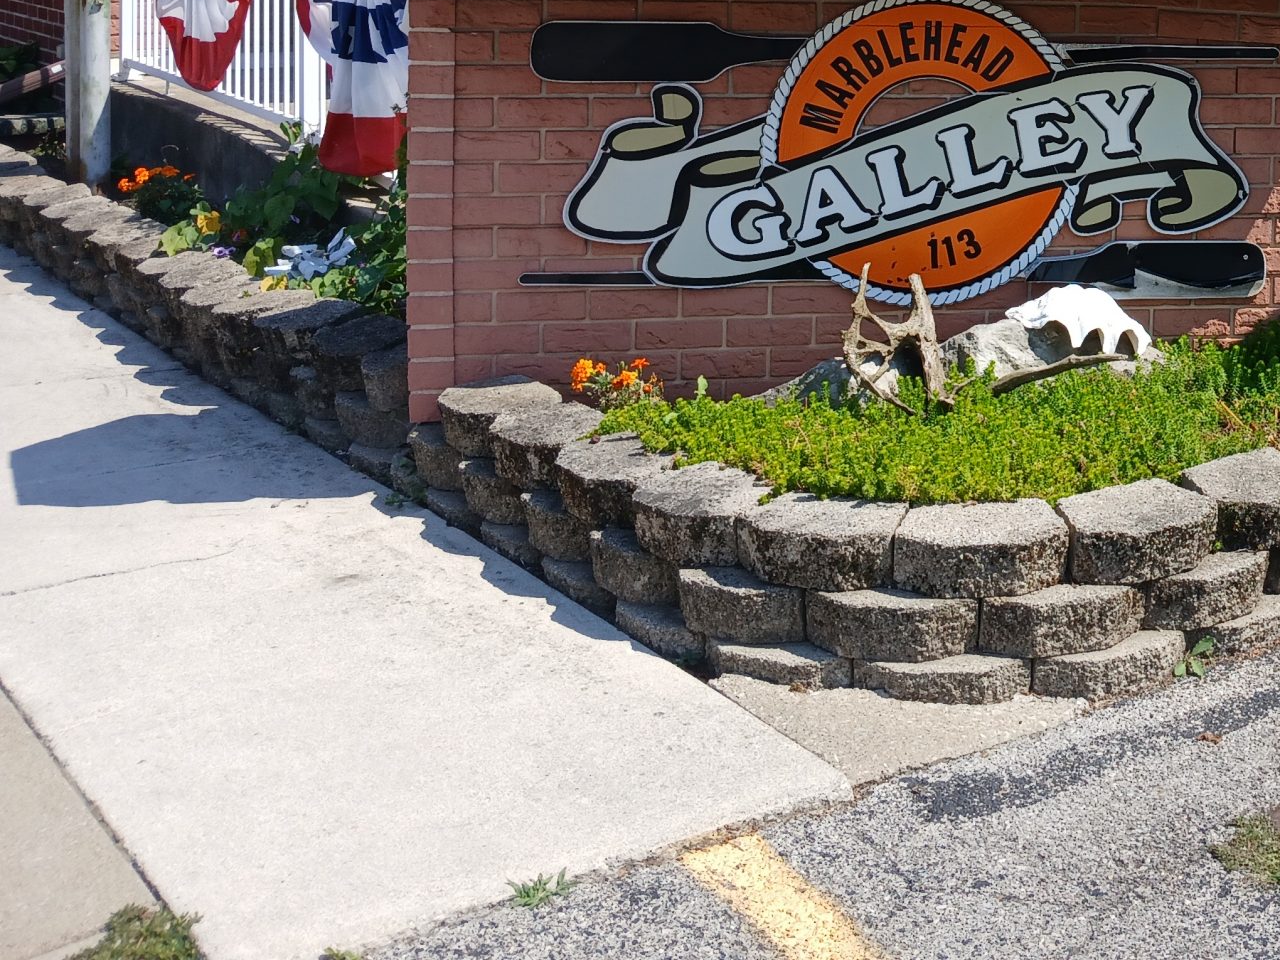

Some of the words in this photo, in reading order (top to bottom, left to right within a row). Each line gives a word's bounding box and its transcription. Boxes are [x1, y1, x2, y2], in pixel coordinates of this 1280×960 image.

[799, 20, 1015, 134] MARBLEHEAD
[704, 83, 1156, 260] GALLEY
[927, 228, 983, 272] 113
